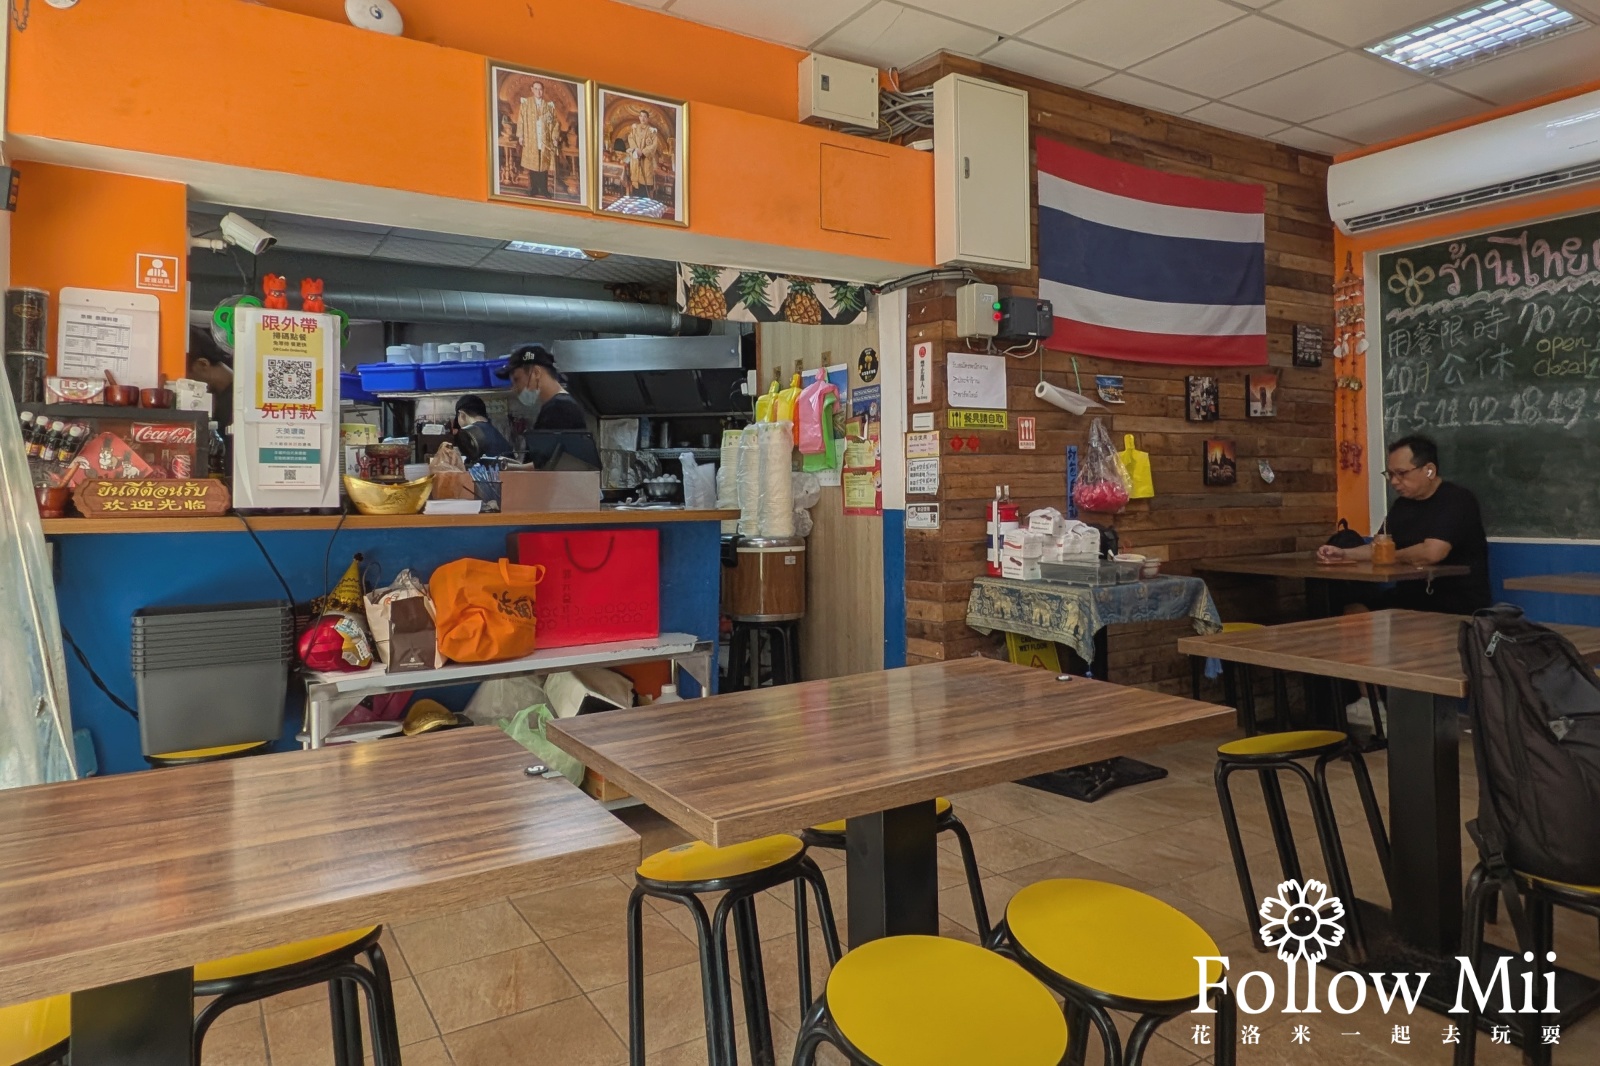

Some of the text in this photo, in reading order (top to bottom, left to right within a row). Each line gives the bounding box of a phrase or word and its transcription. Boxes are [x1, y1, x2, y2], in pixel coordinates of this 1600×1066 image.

[262, 315, 318, 334] 限外帶
[1536, 336, 1592, 360] open
[60, 379, 88, 390] LEO
[261, 403, 317, 420] 先付款
[964, 412, 1004, 424] 餐具請自取
[102, 499, 206, 511] 欢迎光临
